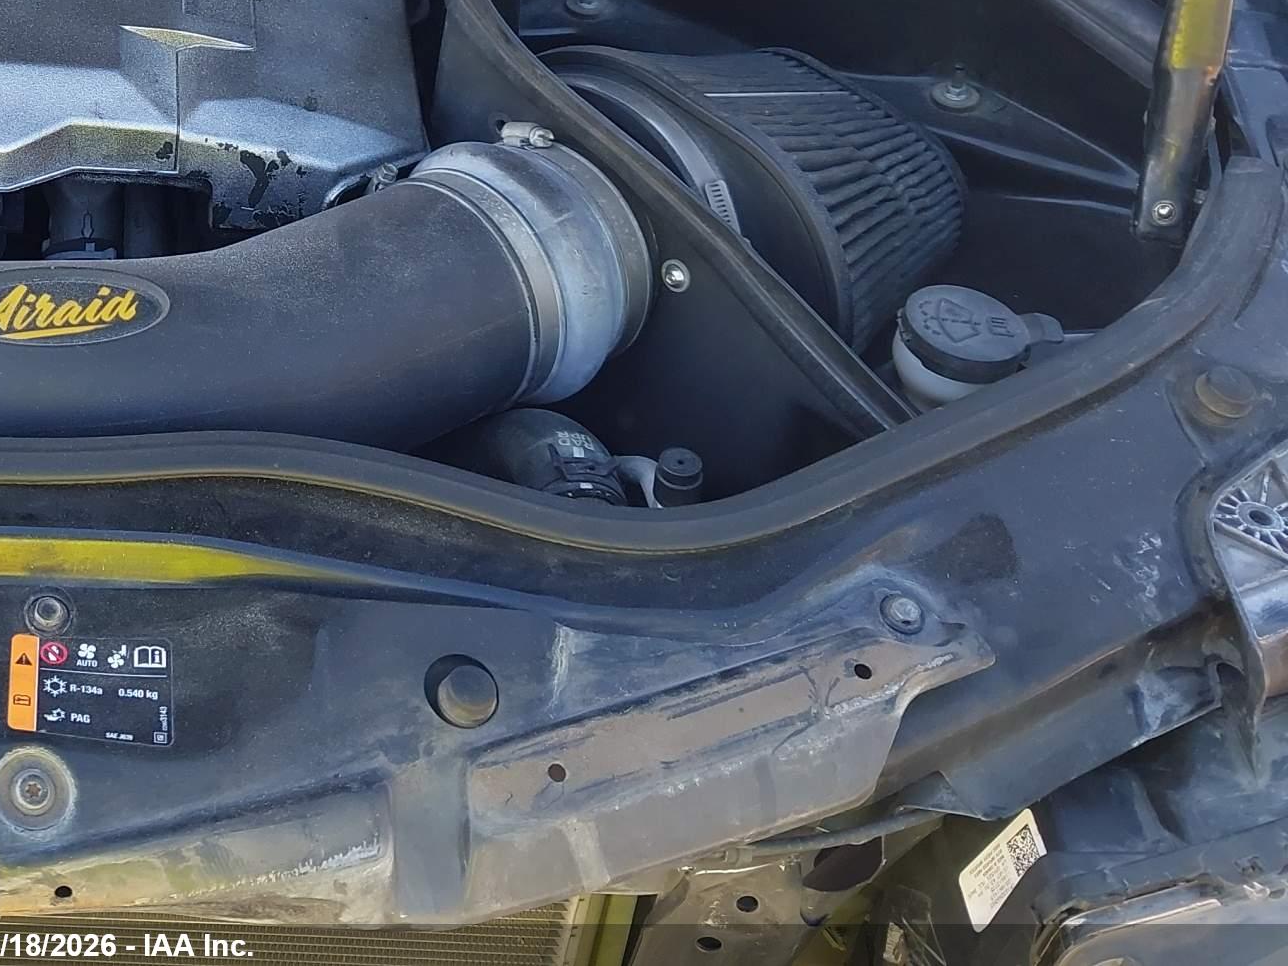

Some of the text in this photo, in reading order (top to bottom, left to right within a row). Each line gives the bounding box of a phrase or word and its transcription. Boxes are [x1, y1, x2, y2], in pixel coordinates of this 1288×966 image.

[76, 659, 98, 668] AUTO
[69, 684, 158, 701] R-134a 0.540 kg
[70, 712, 91, 724] PAG
